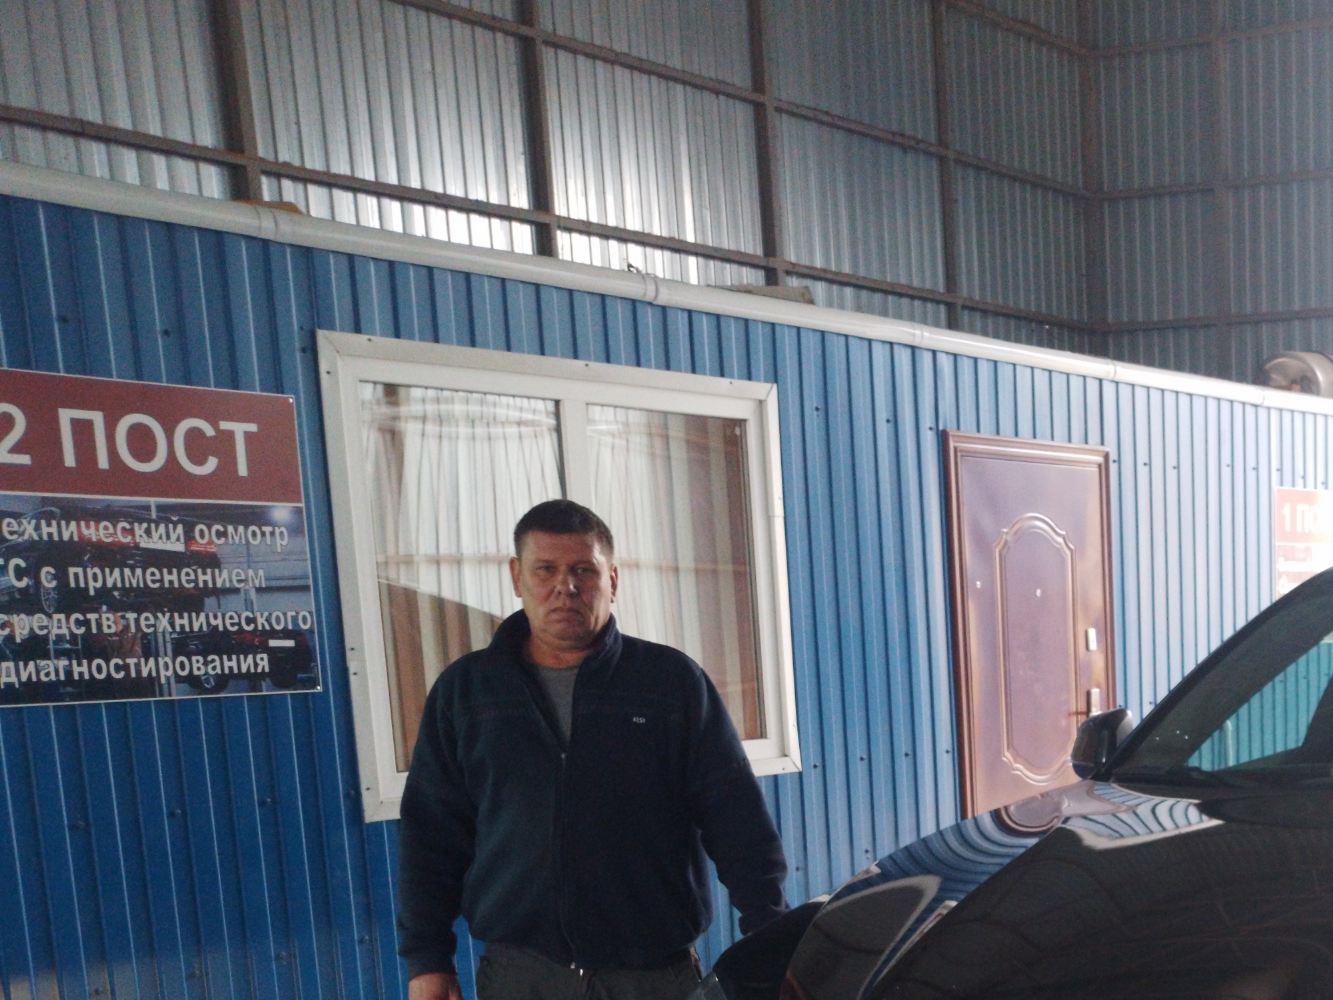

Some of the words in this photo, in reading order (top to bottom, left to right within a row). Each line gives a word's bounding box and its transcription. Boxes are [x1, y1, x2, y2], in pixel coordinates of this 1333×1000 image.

[0, 403, 32, 465] 2
[58, 407, 258, 477] ПОСТ
[1, 516, 185, 545] ехнический
[194, 524, 289, 551] осмотр
[0, 557, 28, 589] С
[40, 566, 58, 588] с
[68, 565, 266, 595] применением
[0, 611, 116, 643] средств
[129, 608, 312, 634] технического
[0, 653, 270, 689] диагностирования
